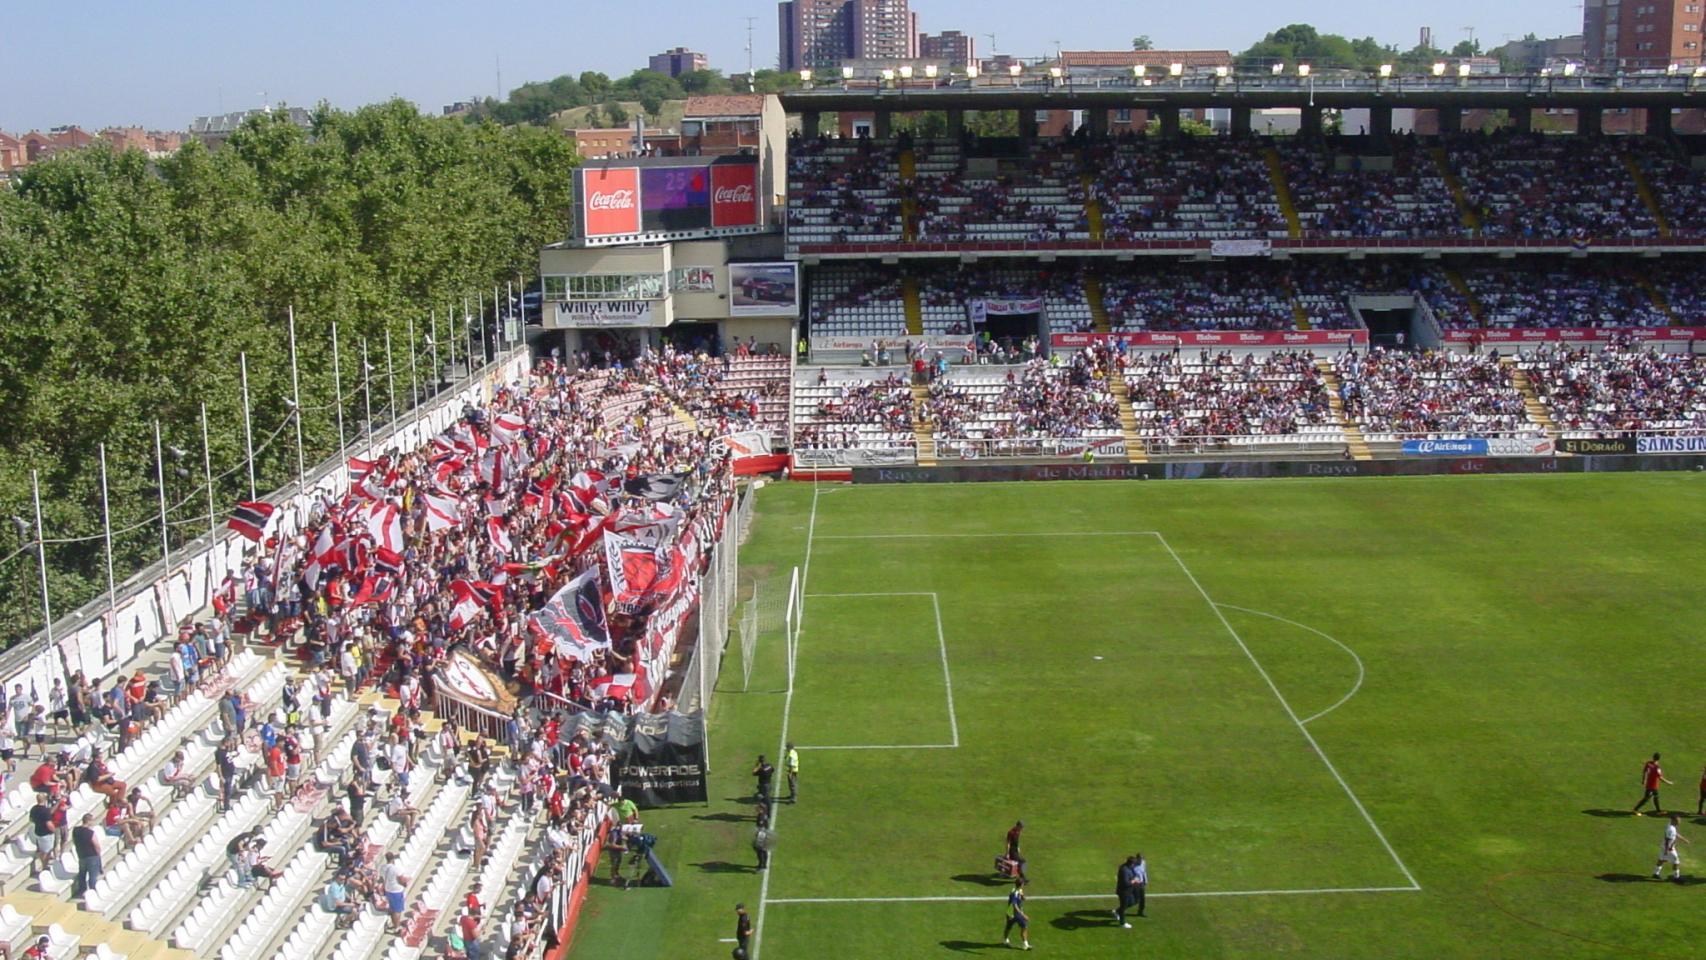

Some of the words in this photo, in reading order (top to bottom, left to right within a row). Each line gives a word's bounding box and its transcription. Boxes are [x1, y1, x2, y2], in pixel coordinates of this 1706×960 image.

[589, 189, 635, 211] Coca-Cola
[714, 185, 754, 204] Coca-Cola
[560, 301, 602, 314] Willy!
[607, 301, 650, 314] Willy!
[1099, 444, 1124, 455] Uno
[1037, 466, 1060, 477] de
[1067, 465, 1138, 477] Madrid
[1308, 463, 1358, 476] Rayo
[1461, 460, 1483, 471] de
[879, 469, 930, 482] Rayo
[619, 764, 701, 777] POWERADE
